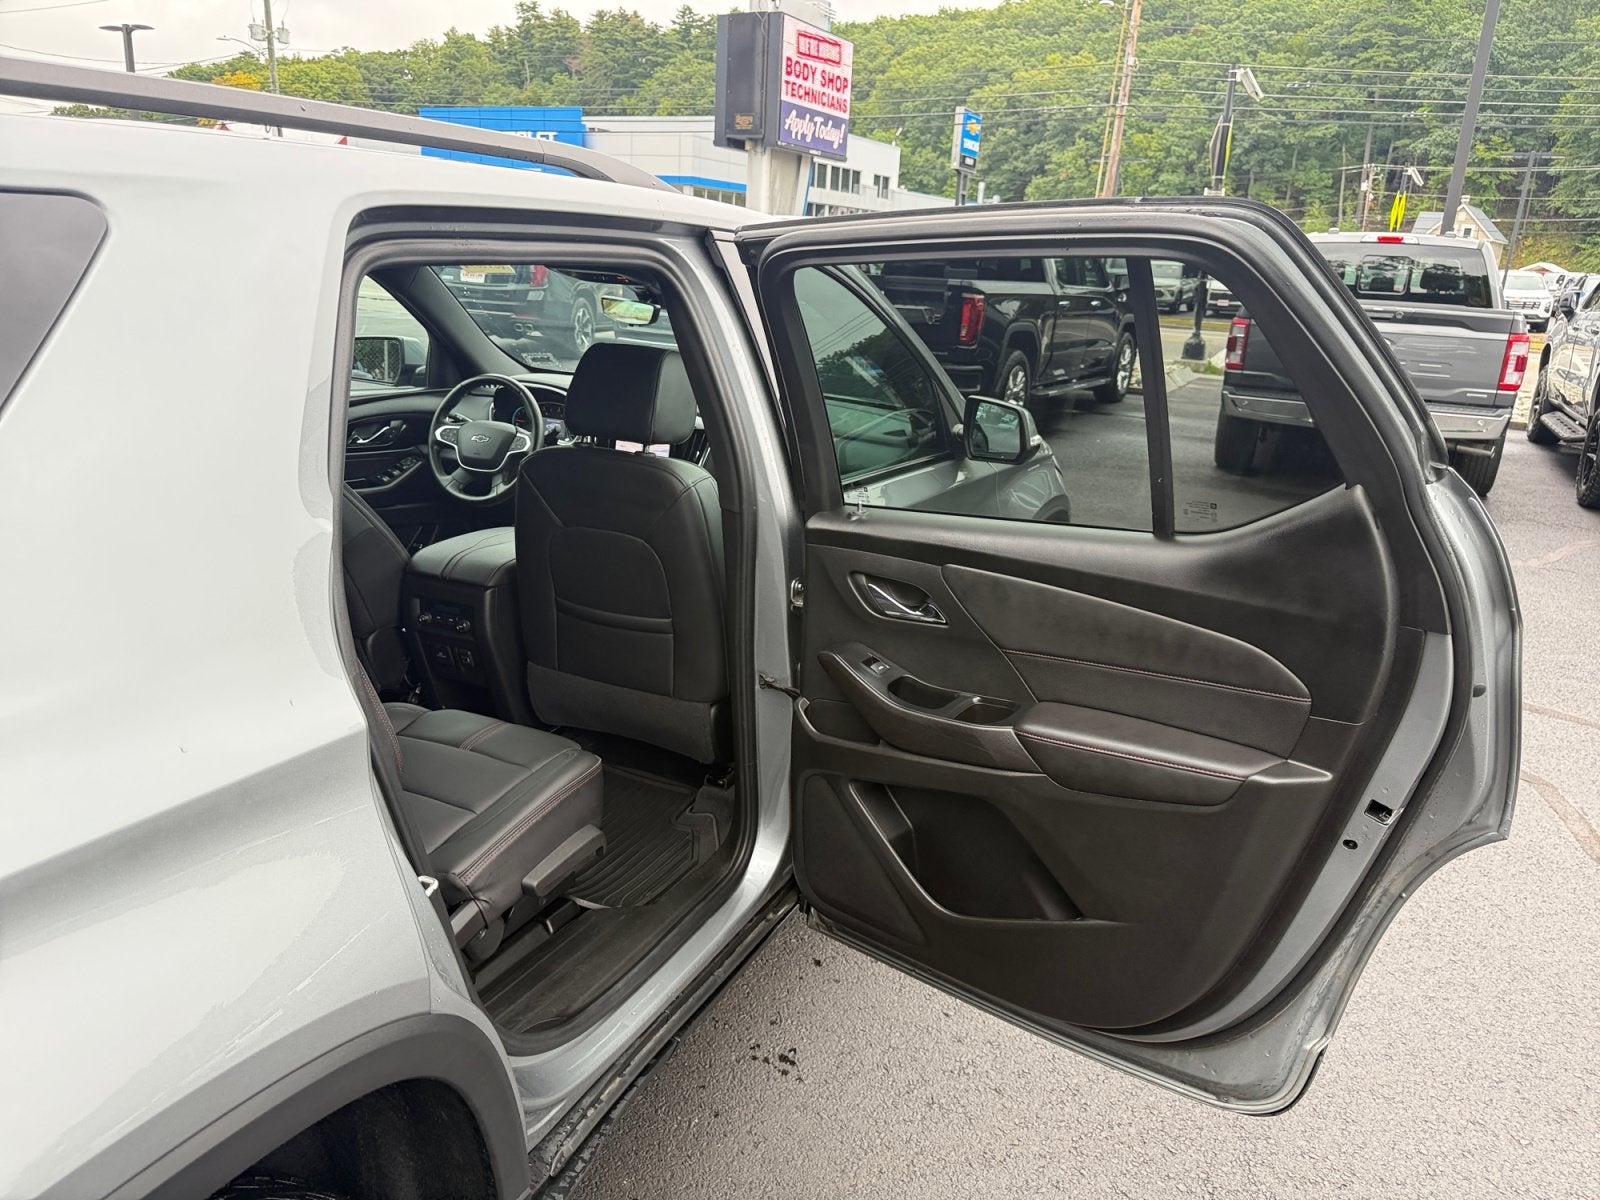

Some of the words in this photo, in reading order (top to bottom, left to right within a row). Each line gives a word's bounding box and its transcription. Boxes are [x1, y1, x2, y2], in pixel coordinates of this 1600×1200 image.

[785, 56, 817, 84] BODY
[820, 69, 849, 94] SHOP
[784, 80, 848, 113] TECHNICIANS
[784, 109, 815, 143] Apply
[813, 116, 846, 150] Today!
